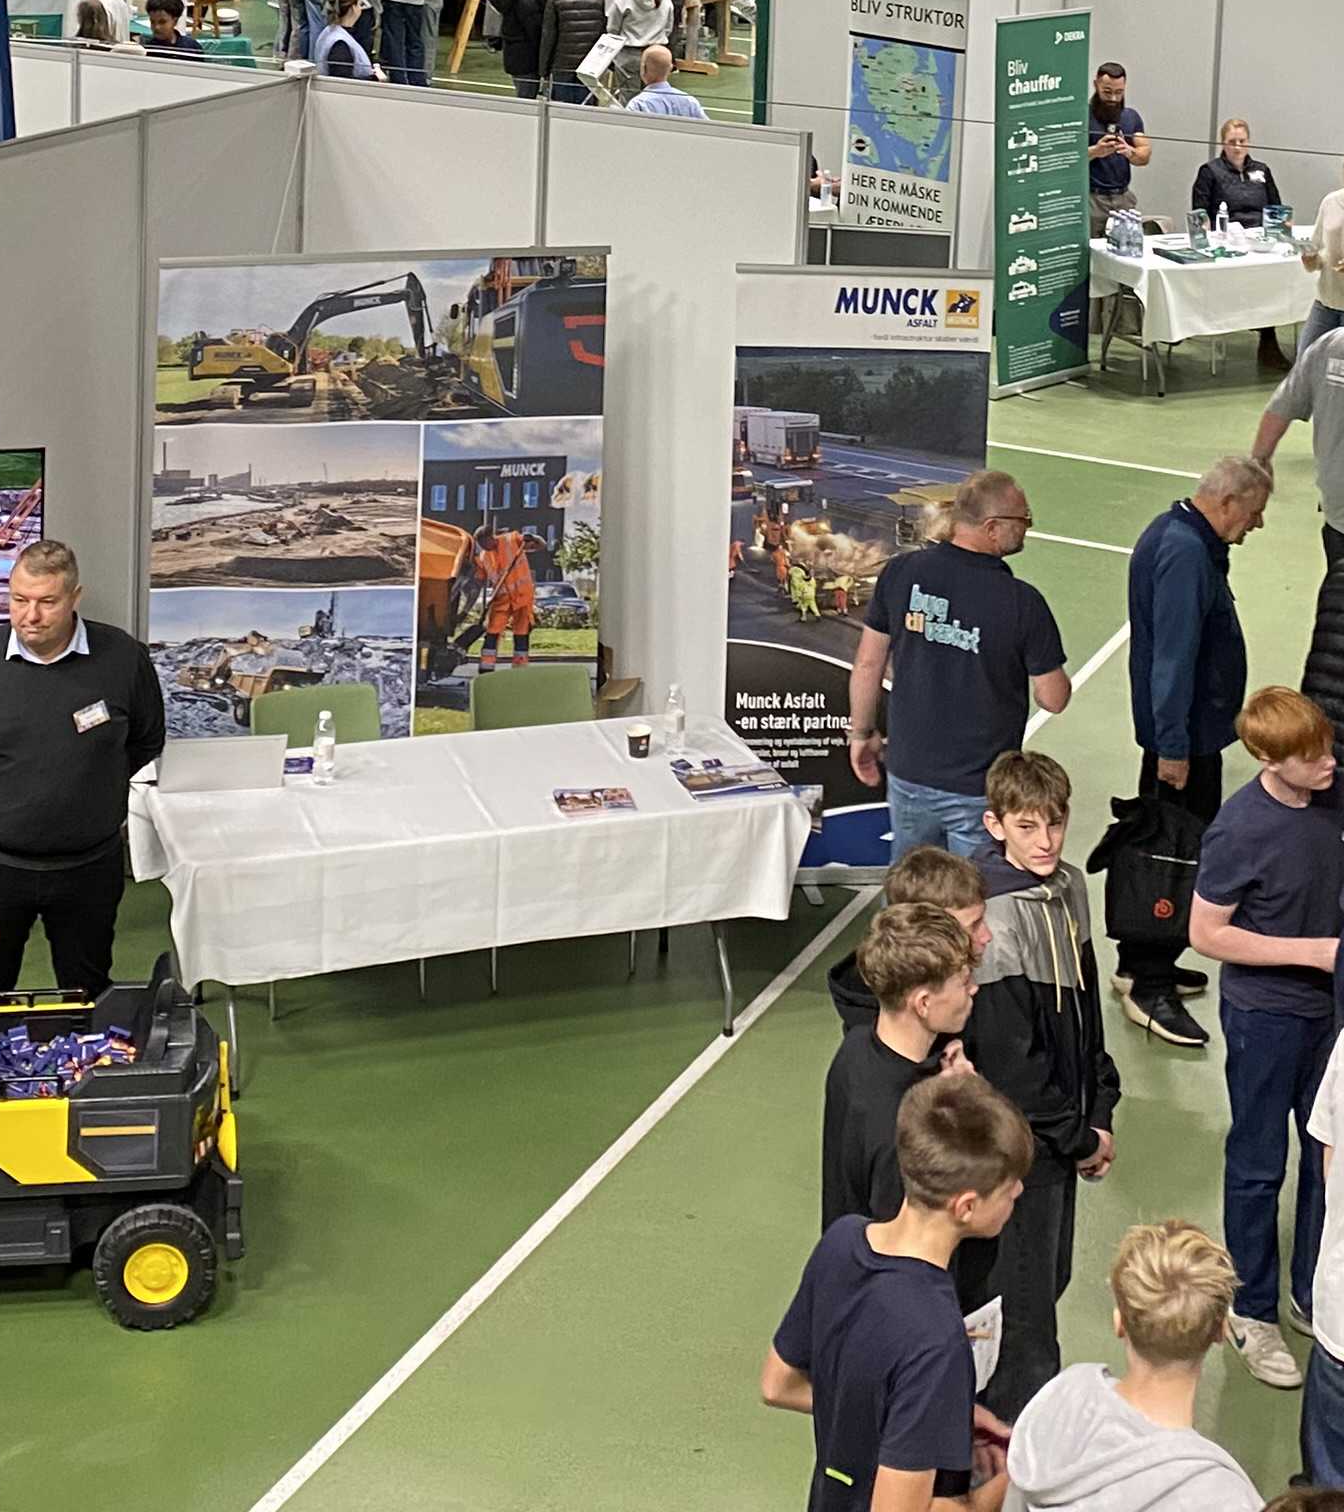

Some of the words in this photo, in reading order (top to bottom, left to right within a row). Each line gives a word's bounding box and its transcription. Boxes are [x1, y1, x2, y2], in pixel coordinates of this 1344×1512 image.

[886, 2, 965, 30] STRUKTØR
[1063, 30, 1086, 42] DEKRA
[1008, 60, 1029, 76] Bliv
[1008, 74, 1062, 96] chauffør
[851, 172, 877, 190] HER
[880, 178, 897, 194] ER
[899, 181, 941, 204] MÅSKE
[848, 191, 869, 208] DIN
[873, 197, 943, 224] KOMMENDE
[834, 286, 939, 316] MUNCK
[906, 318, 938, 328] ASFALT
[500, 461, 546, 478] MUNCK
[736, 692, 782, 709] Munck
[783, 692, 826, 709] Asfalt
[735, 716, 758, 730] -en
[760, 713, 802, 730] stærk
